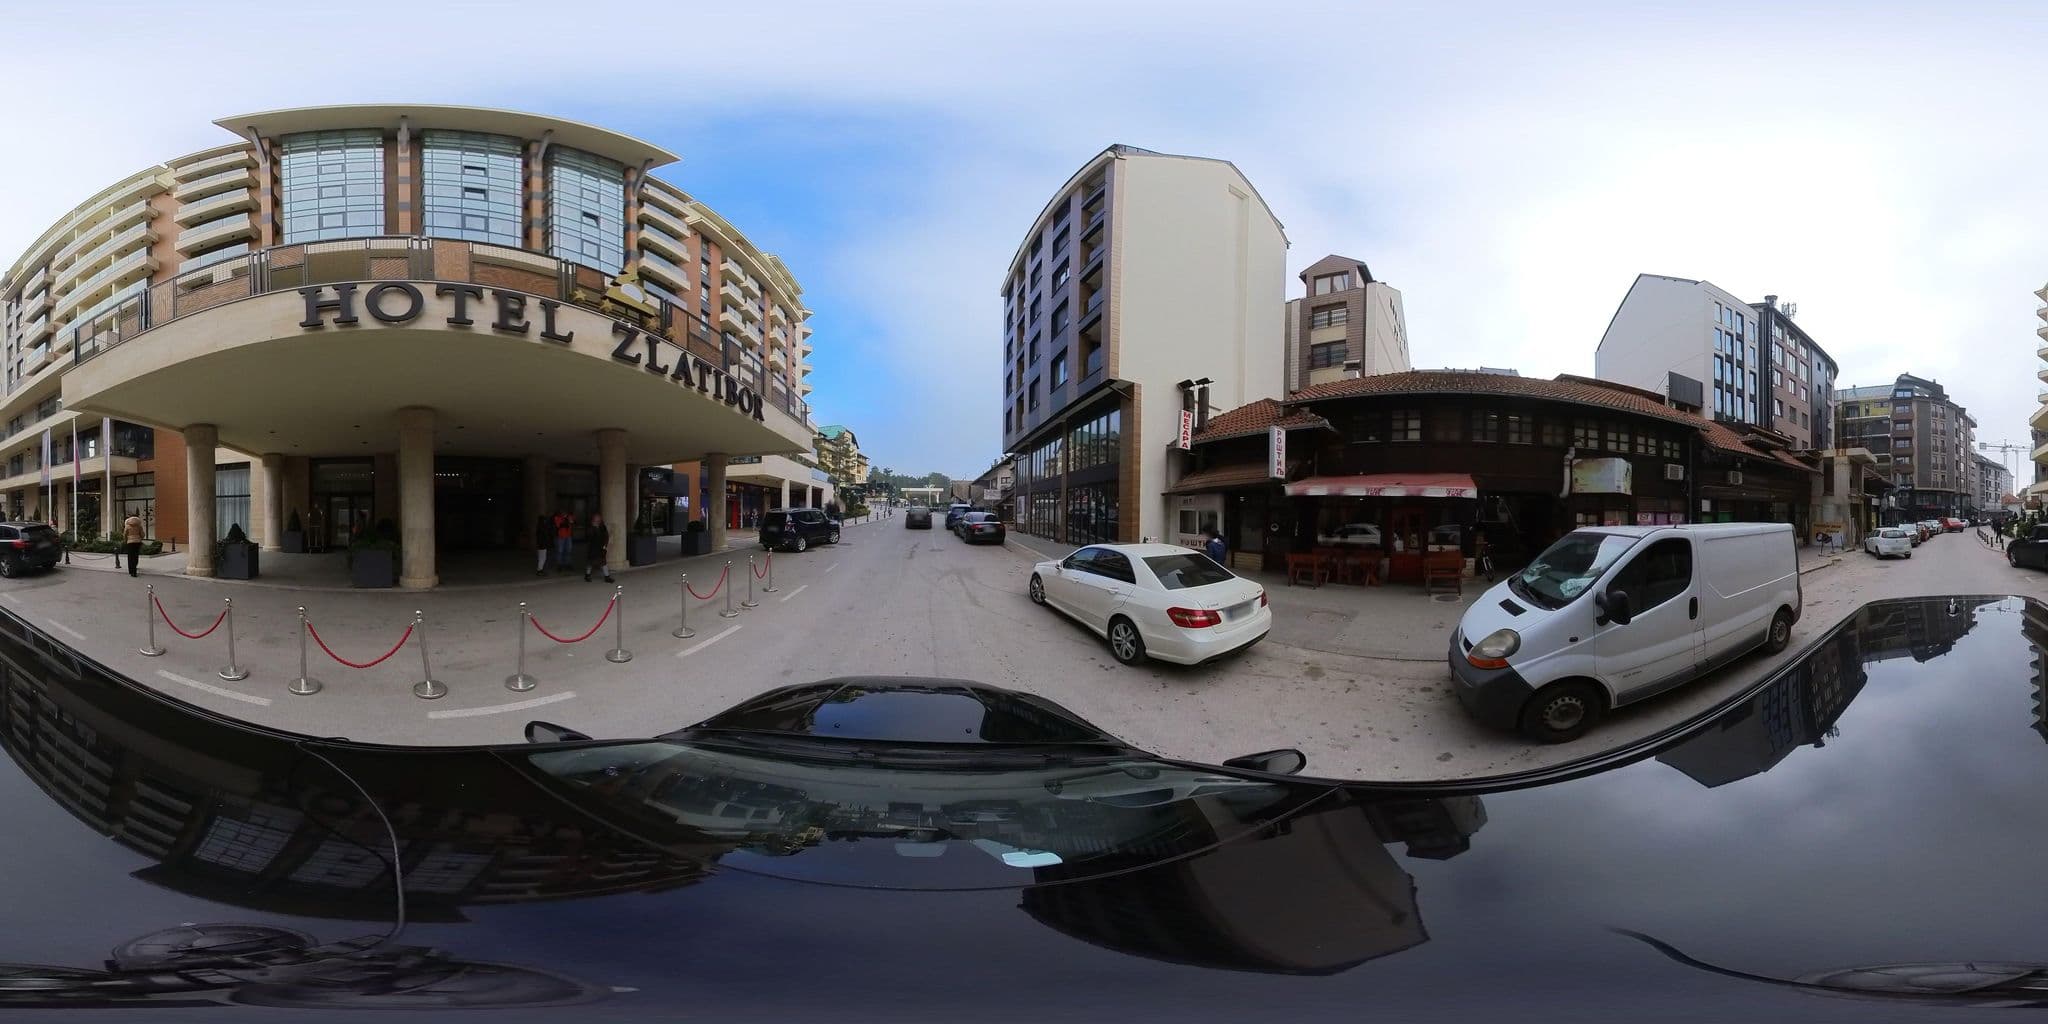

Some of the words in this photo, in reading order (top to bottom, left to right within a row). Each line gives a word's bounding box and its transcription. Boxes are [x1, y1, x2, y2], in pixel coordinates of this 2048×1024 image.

[299, 282, 574, 343] HOTEL
[612, 321, 766, 421] ZLATIBOR
[1182, 411, 1192, 449] МЕСАРА
[1276, 430, 1285, 476] РОШТИЉ
